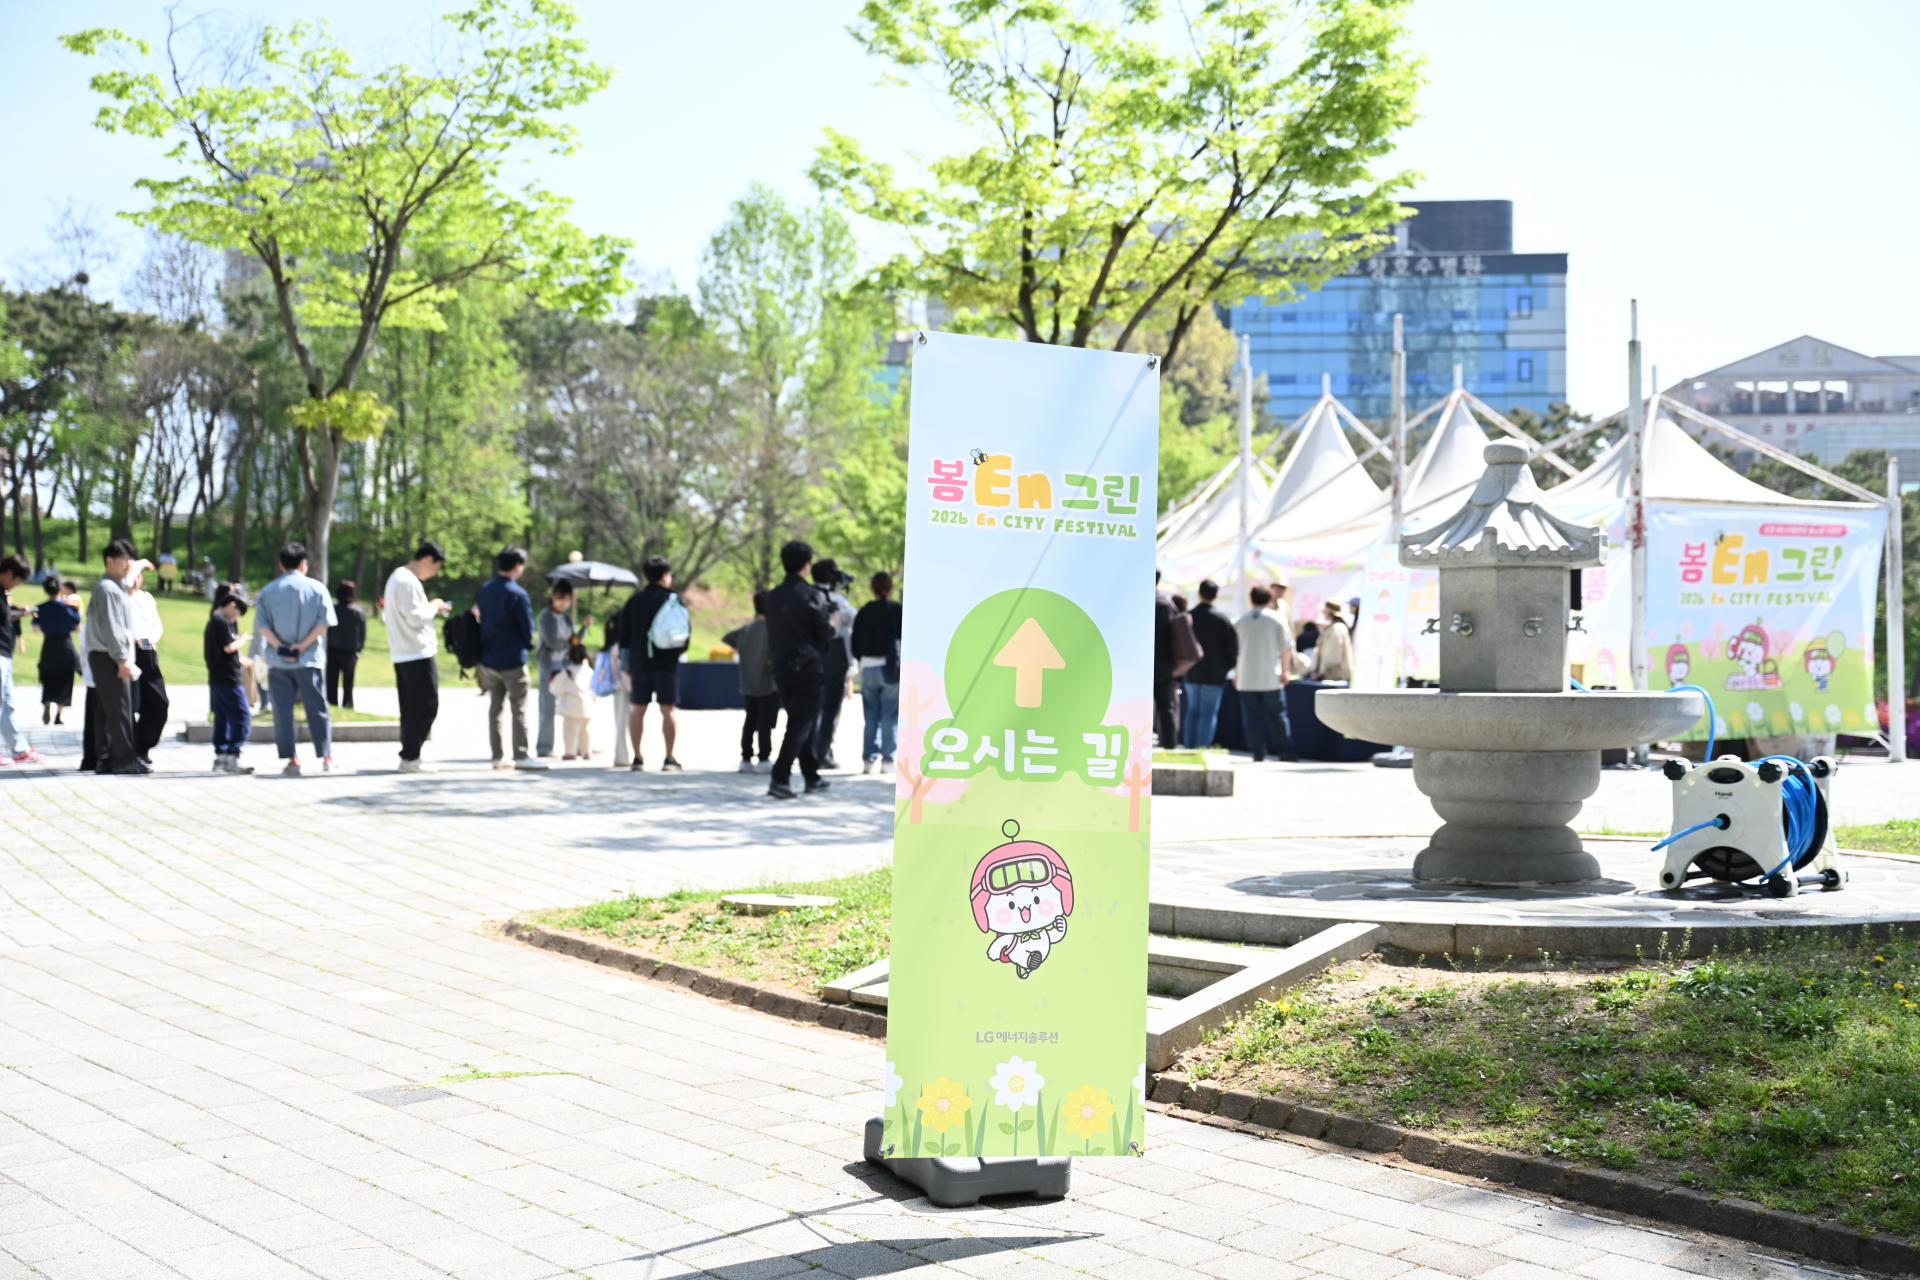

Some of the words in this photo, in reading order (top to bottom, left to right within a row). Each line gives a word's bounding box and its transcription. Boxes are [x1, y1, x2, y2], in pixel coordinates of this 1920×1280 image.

[931, 509, 968, 525] 2026
[977, 513, 996, 526] En
[1003, 515, 1045, 531] CITY
[1053, 518, 1137, 538] FESTIVAL
[1730, 592, 1762, 606] CITY
[1767, 591, 1833, 606] FESTIVAL
[928, 727, 1059, 774] 오시는
[1082, 732, 1122, 779] 길
[976, 1031, 995, 1044] LG
[996, 1031, 1059, 1044] 에너지솔루션
